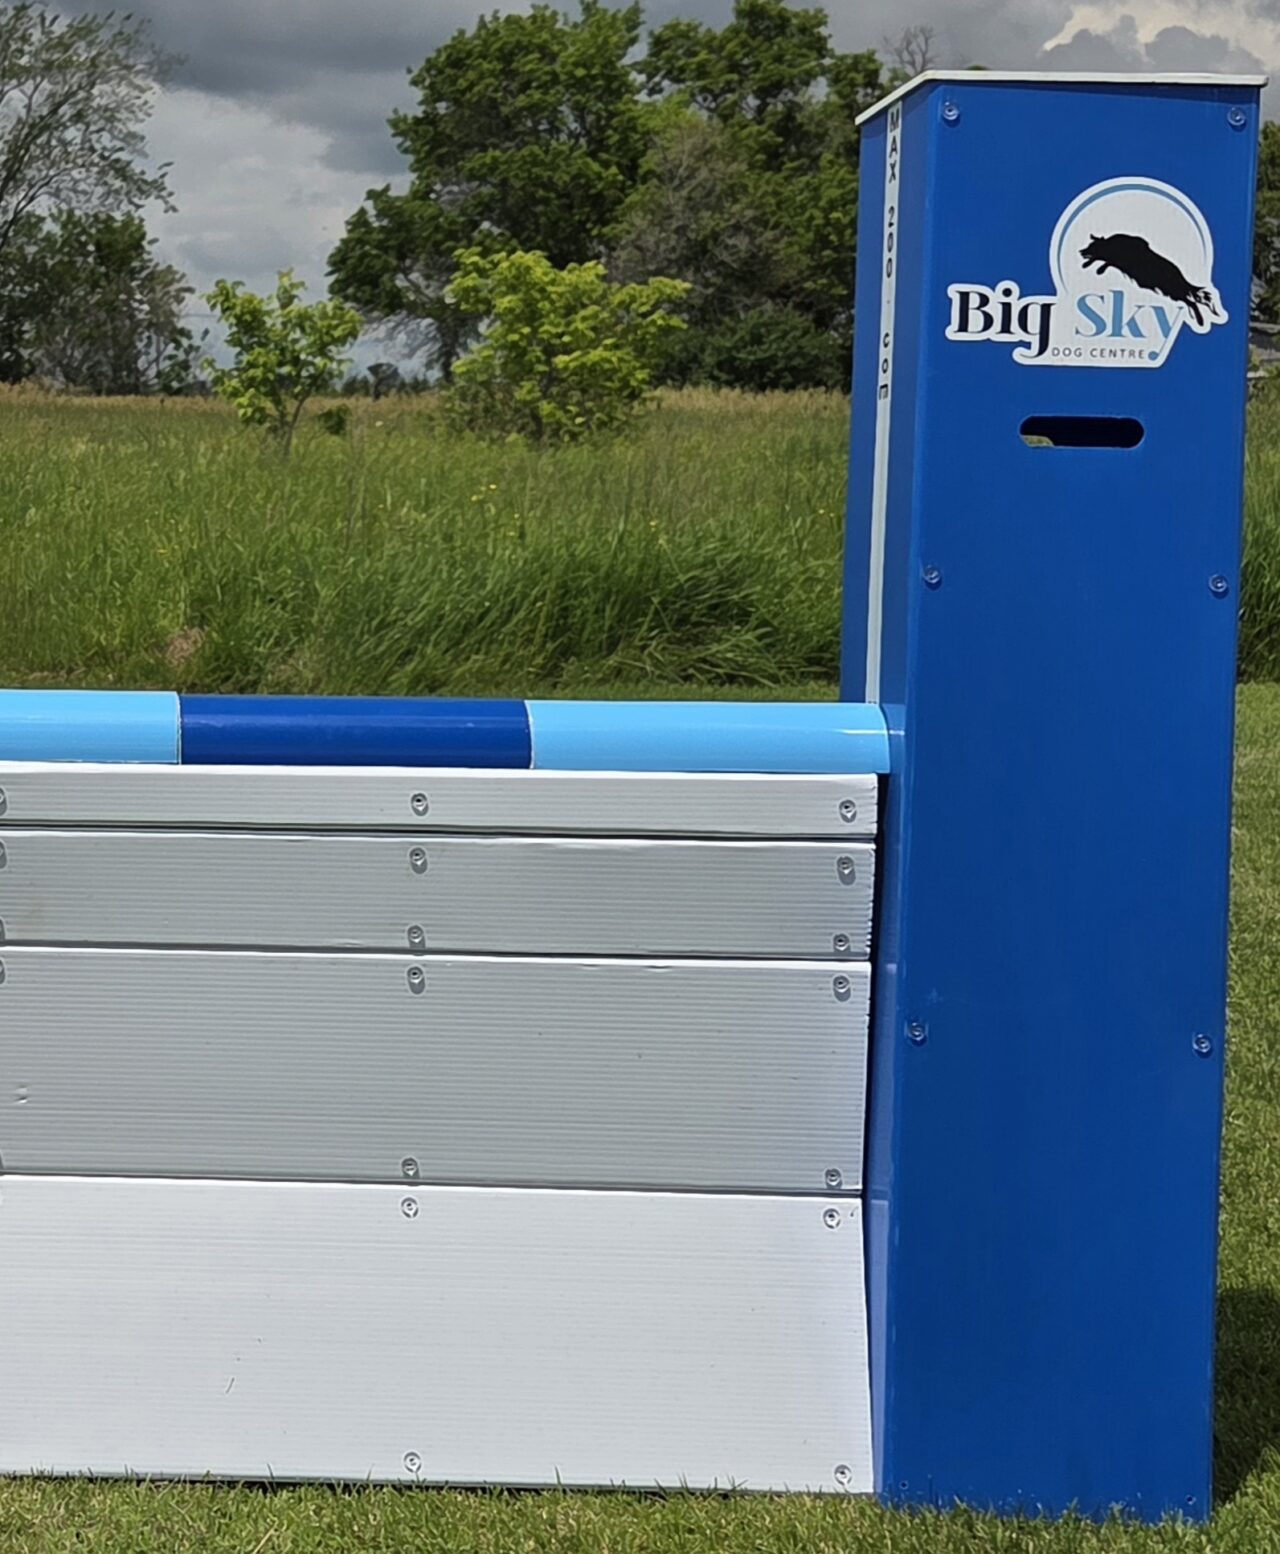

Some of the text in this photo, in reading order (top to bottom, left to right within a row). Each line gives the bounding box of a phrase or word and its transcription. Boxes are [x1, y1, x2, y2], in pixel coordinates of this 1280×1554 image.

[953, 287, 1184, 361] Big Sky
[1051, 346, 1145, 360] DOG CENTRE
